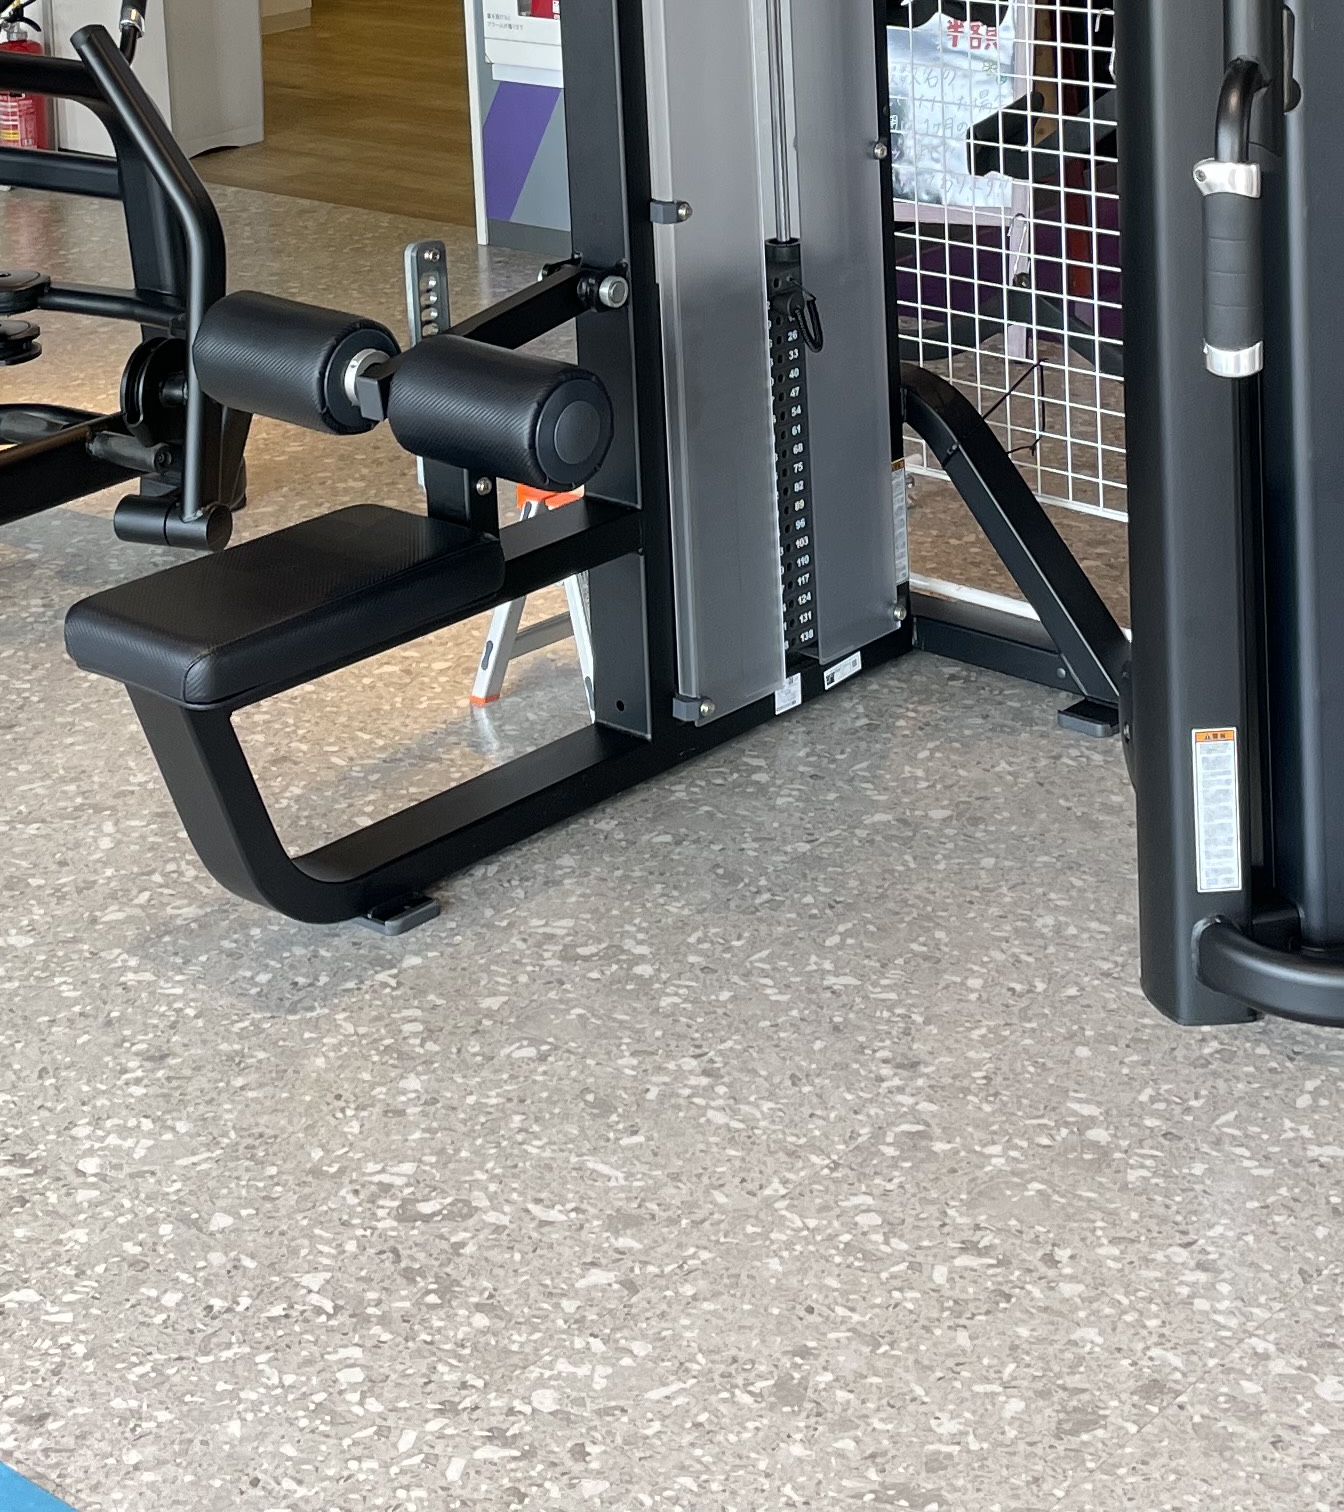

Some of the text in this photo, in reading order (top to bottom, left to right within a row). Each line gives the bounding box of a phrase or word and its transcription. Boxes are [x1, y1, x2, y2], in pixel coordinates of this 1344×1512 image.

[789, 349, 799, 361] 33
[797, 555, 810, 568] 110
[797, 573, 810, 586] 117
[798, 591, 812, 605] 124
[799, 611, 812, 624] 131
